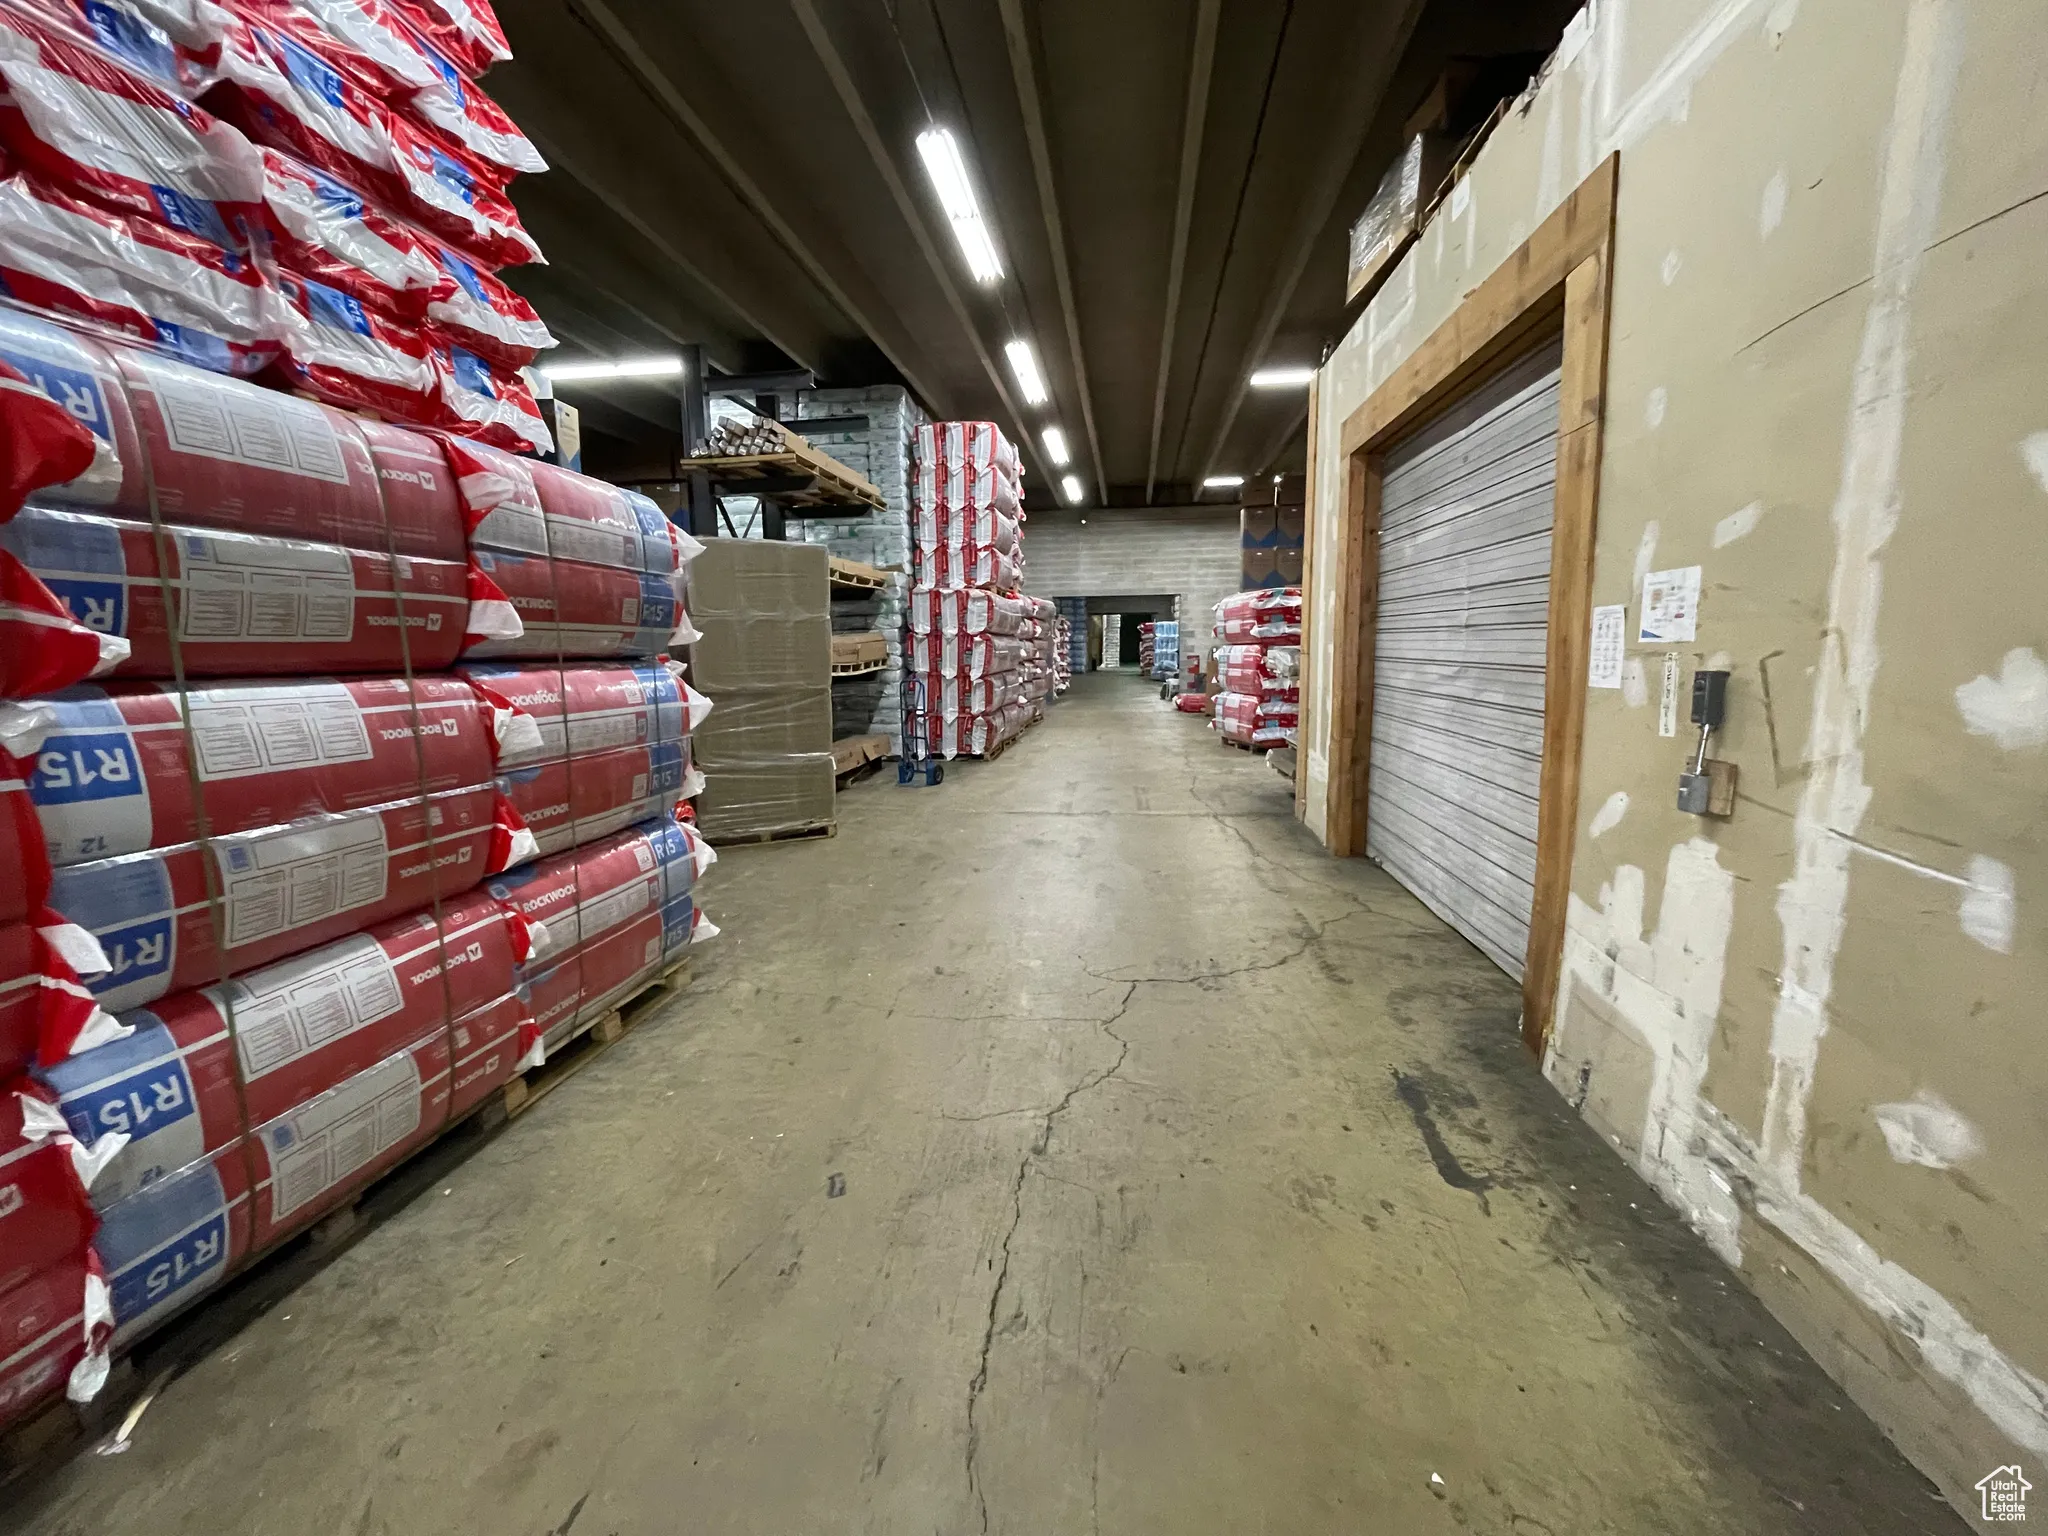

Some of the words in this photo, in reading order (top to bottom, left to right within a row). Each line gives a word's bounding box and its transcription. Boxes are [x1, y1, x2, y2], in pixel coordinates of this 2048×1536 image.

[38, 748, 131, 789] R15
[100, 1074, 184, 1133] R15
[146, 1229, 219, 1300] R15
